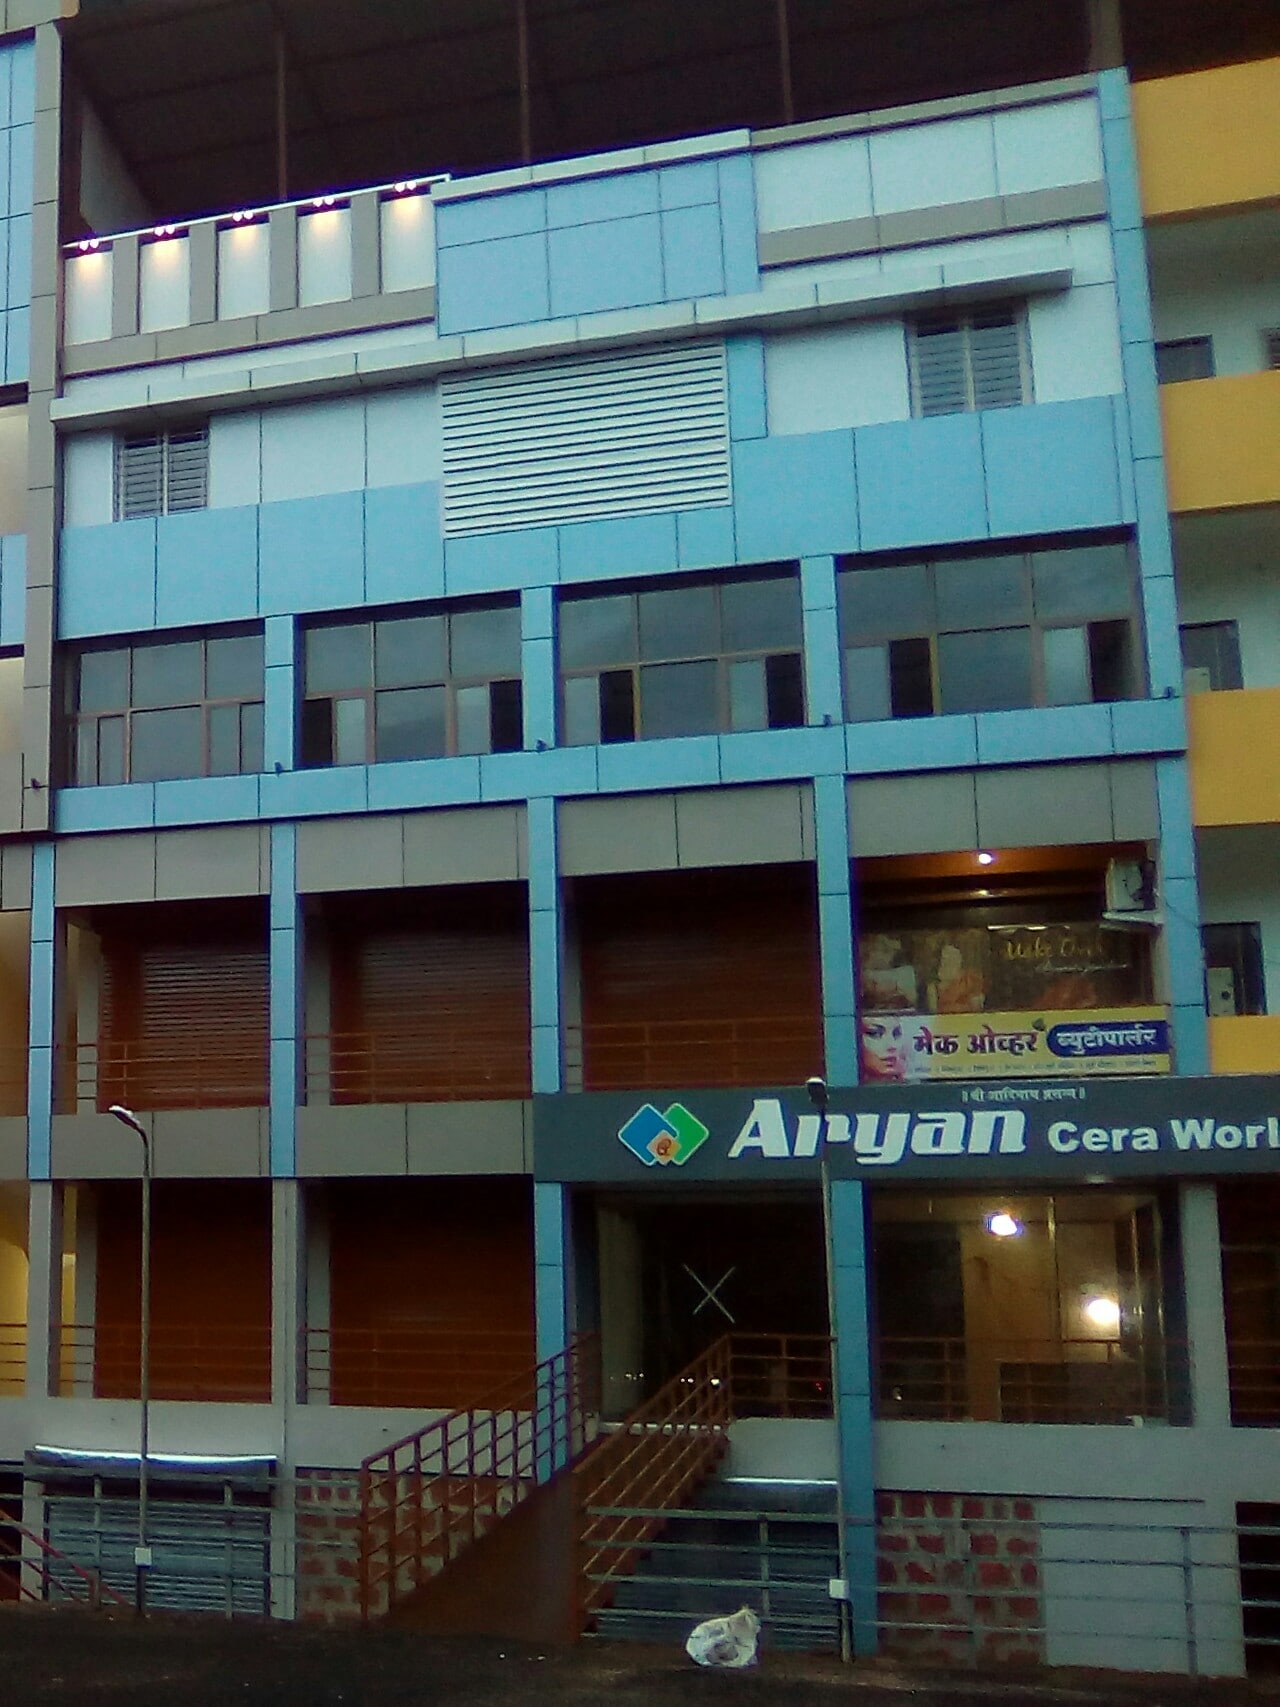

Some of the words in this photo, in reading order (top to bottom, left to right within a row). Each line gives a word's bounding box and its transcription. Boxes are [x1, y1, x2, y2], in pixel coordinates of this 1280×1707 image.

[912, 1025, 959, 1055] मेक
[966, 1023, 1039, 1056] ओव्हर
[727, 1098, 1027, 1165] Aryan
[1046, 1119, 1158, 1153] Cera
